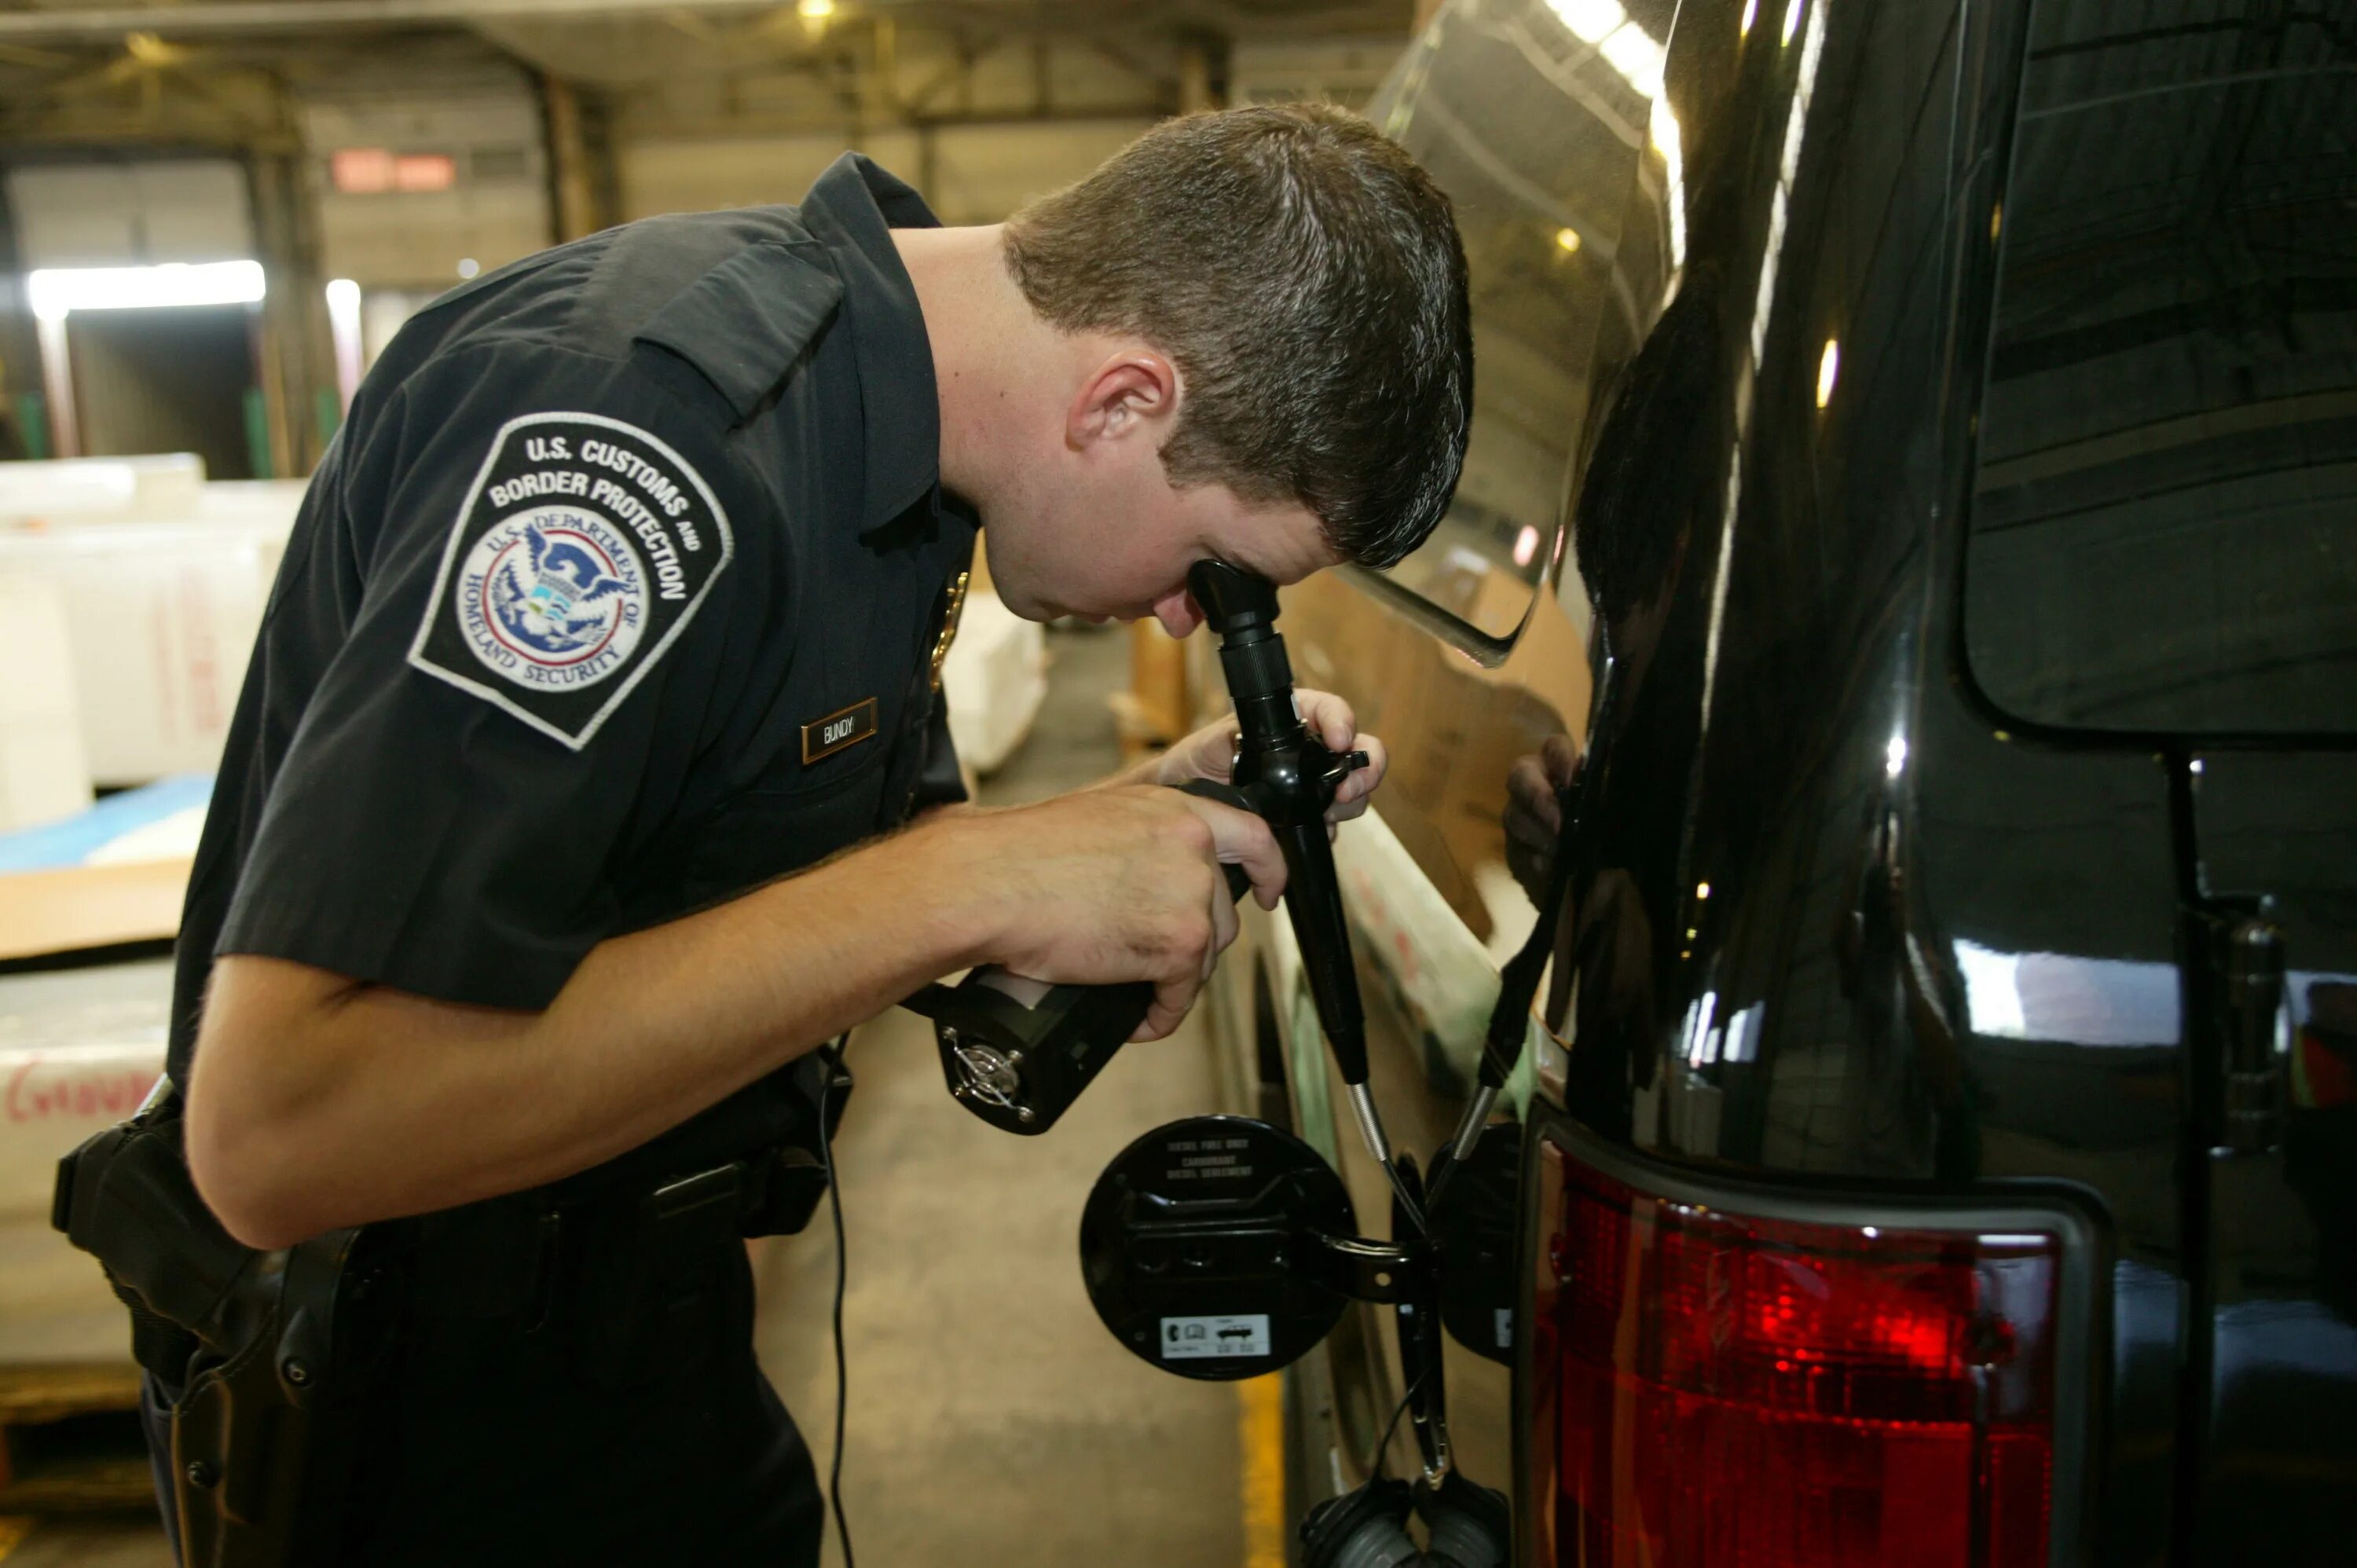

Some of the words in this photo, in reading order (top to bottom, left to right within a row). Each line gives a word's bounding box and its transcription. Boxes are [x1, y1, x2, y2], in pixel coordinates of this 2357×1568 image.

[489, 471, 589, 508] BORDER
[590, 478, 687, 600] PROTECTION
[526, 437, 573, 462] U.S.
[581, 439, 690, 517] CUSTOMS
[675, 521, 702, 551] AND
[535, 513, 640, 595] DEPARTMENT
[624, 603, 640, 628] OF
[465, 574, 518, 668] HOMELAND
[524, 645, 621, 684] SECURITY
[823, 716, 854, 745] BUNDY
